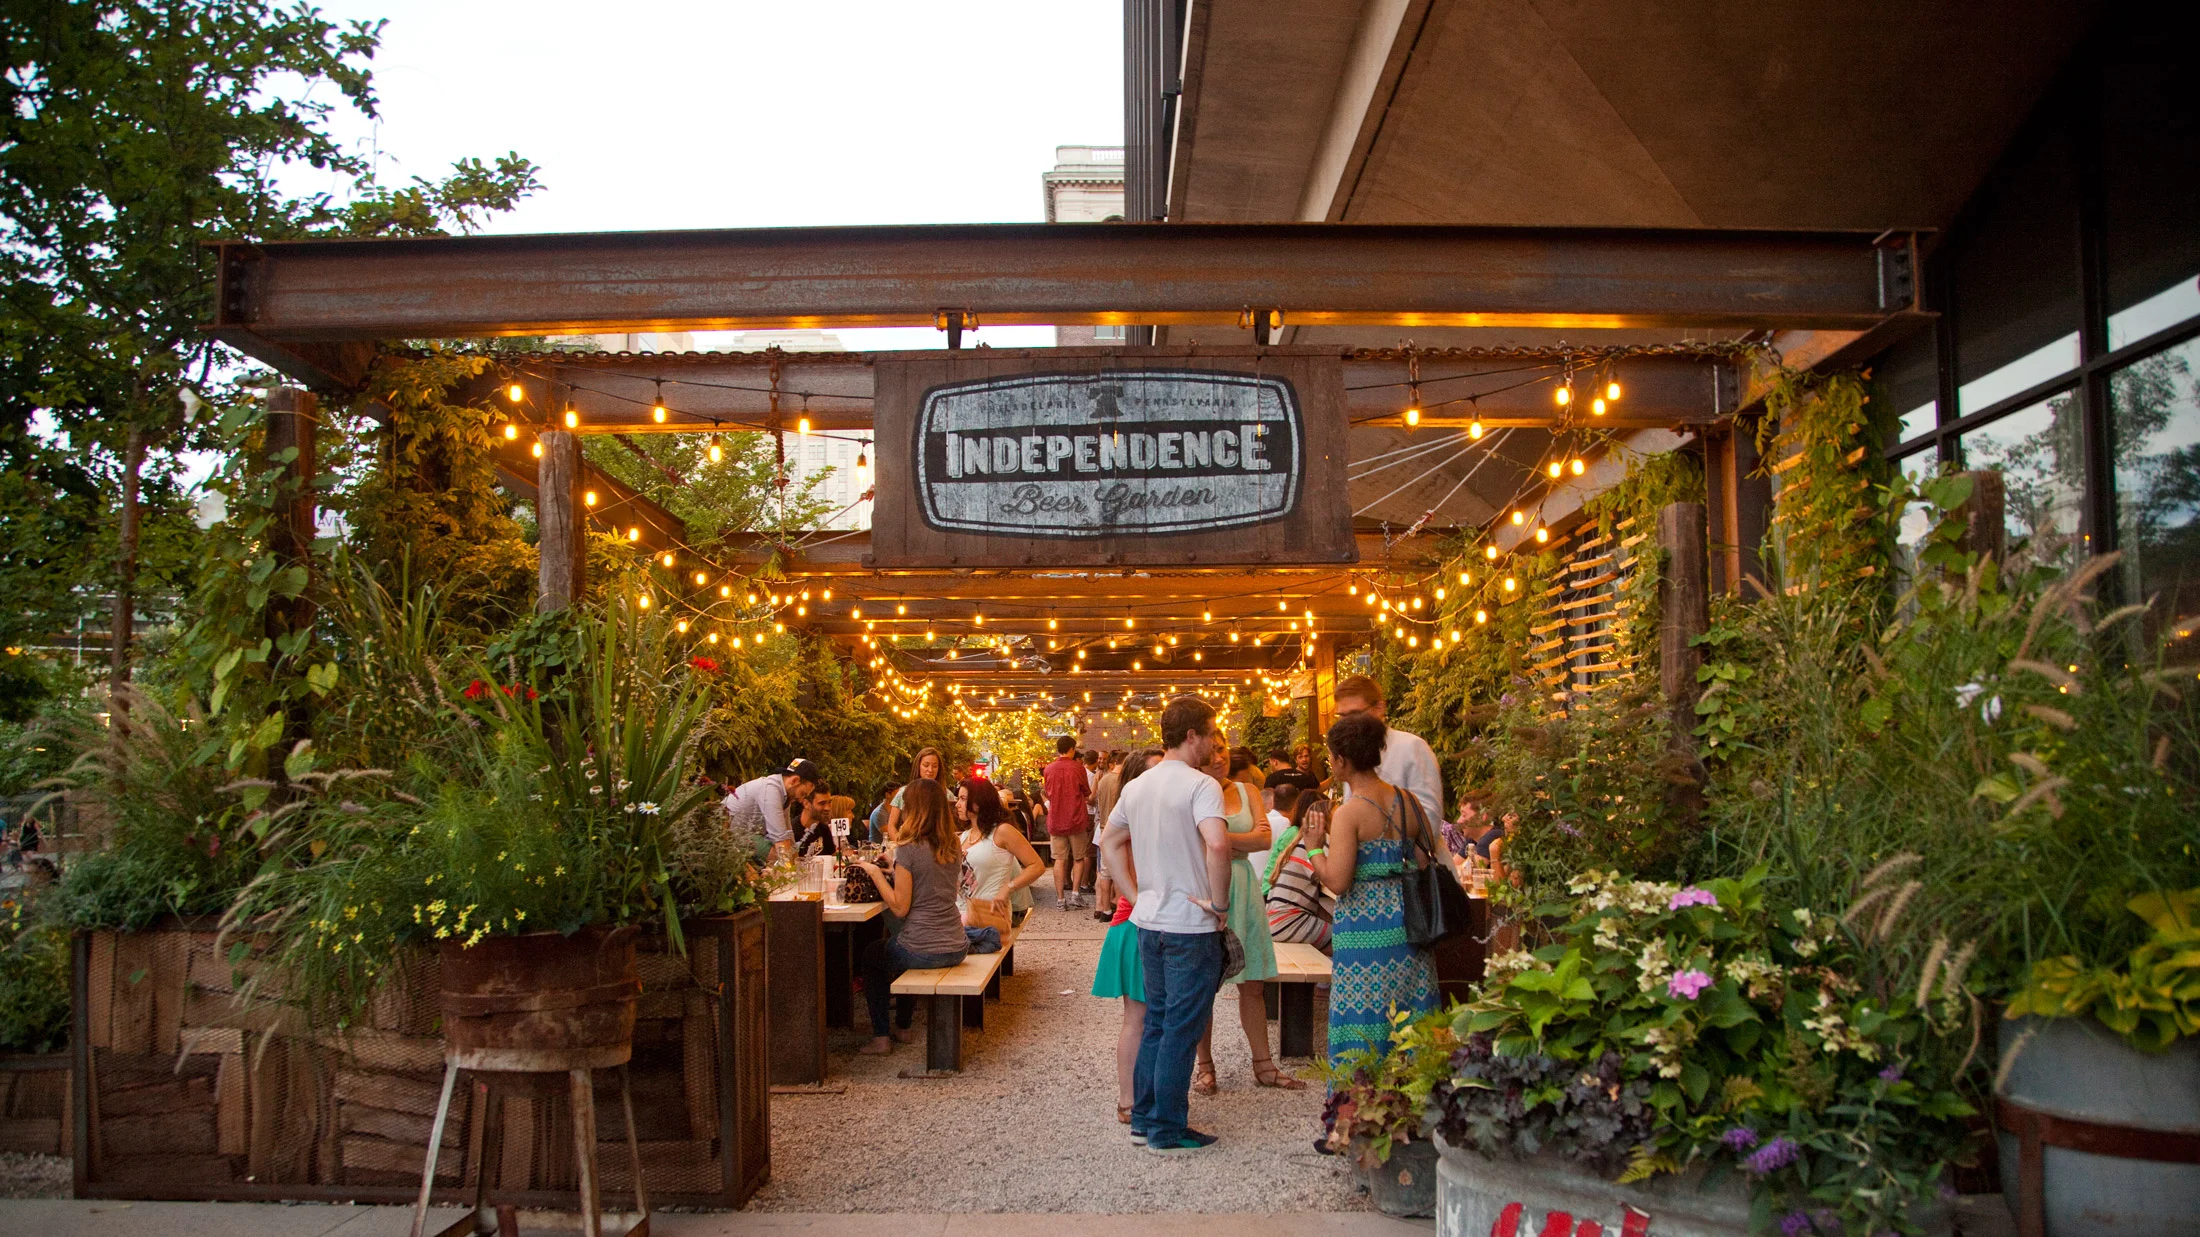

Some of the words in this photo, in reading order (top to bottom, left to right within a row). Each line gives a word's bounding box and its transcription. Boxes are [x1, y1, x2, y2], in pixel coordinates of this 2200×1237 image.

[1134, 398, 1235, 408] PENNSYLVANIA
[947, 425, 1271, 478] INDEPENDENCE
[1000, 483, 1089, 515] Beer
[1094, 483, 1216, 523] Garden
[834, 820, 847, 831] 146
